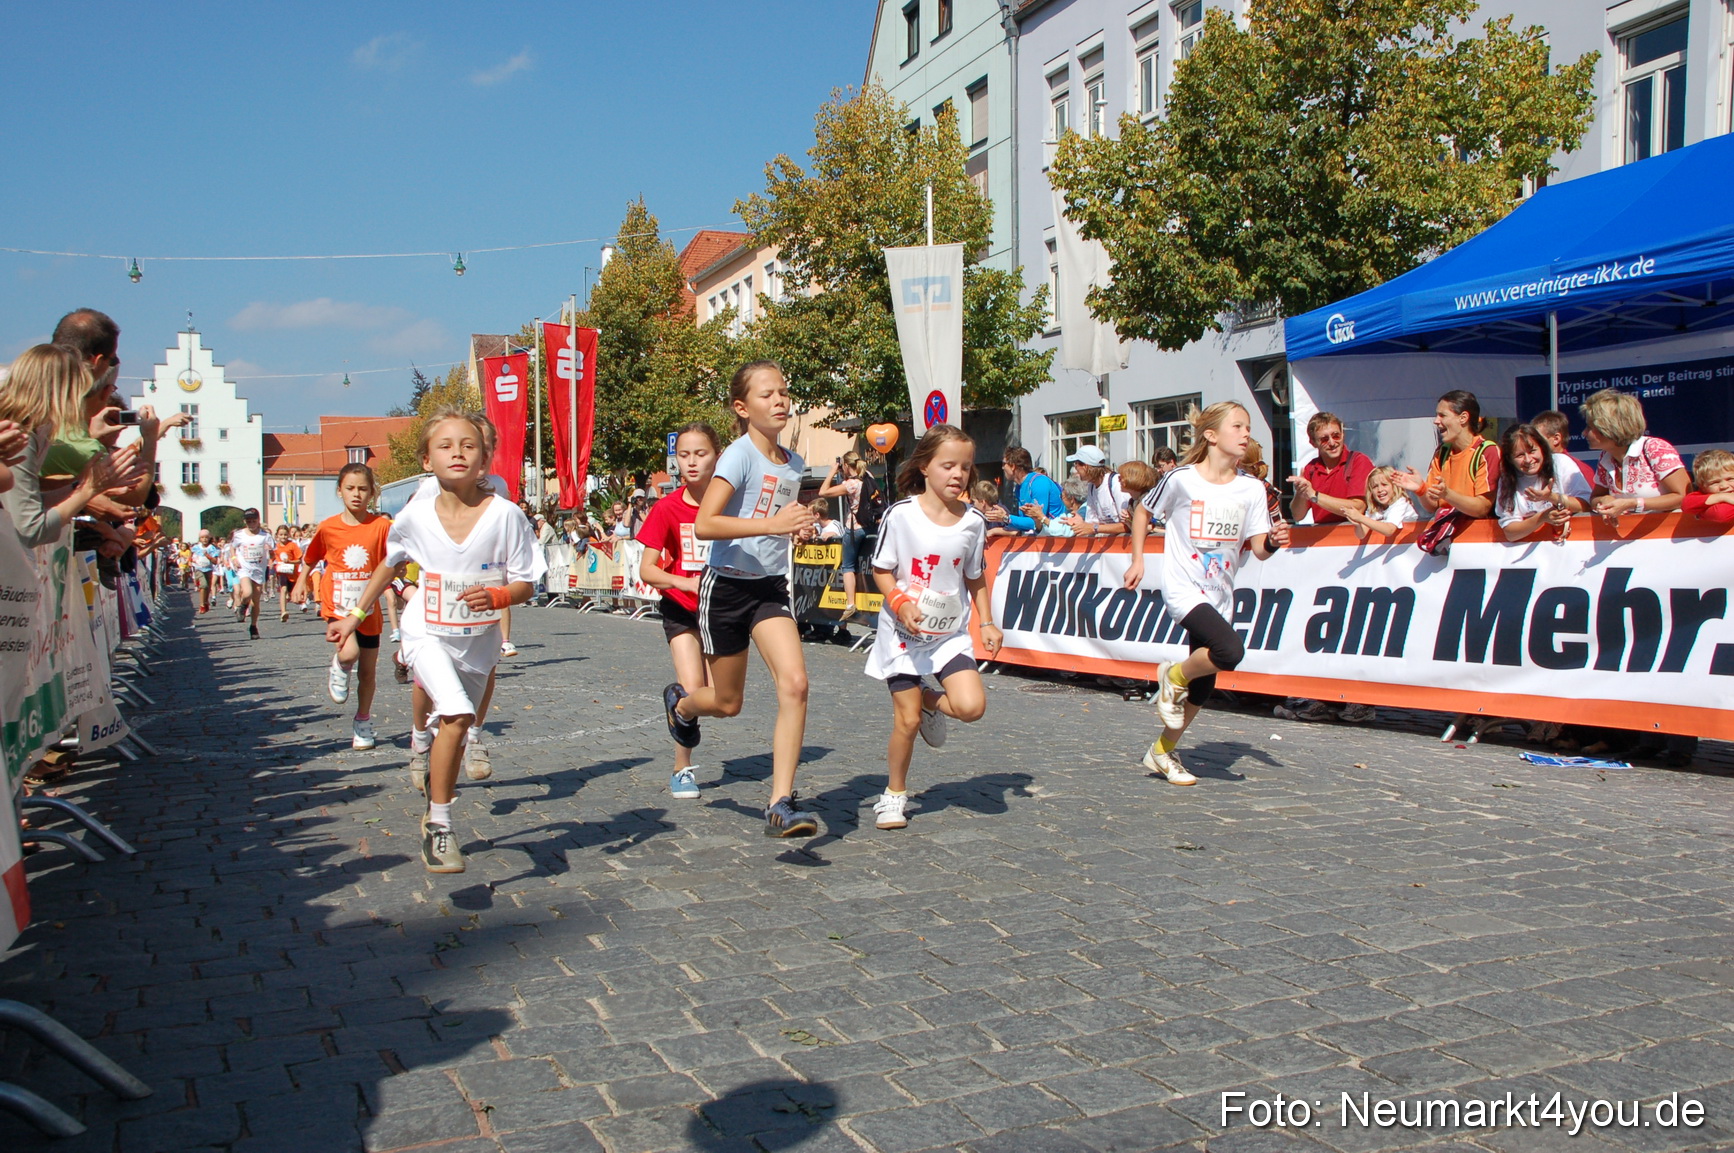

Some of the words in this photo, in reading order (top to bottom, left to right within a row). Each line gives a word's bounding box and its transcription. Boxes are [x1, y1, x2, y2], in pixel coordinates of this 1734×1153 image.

[1454, 255, 1655, 310] www.vereinigte-ikk.de
[1558, 378, 1607, 393] Typisch
[1612, 375, 1638, 388] IKK:
[1642, 373, 1664, 385] Der
[1668, 368, 1713, 383] Beitrag
[1716, 365, 1734, 377] sti
[1558, 395, 1578, 405] die
[1642, 385, 1675, 398] auch!
[777, 484, 791, 496] Anna
[1205, 506, 1240, 520] ALINA
[1207, 521, 1239, 536] 7285
[427, 595, 437, 605] K3
[828, 594, 847, 605] Neumar
[921, 594, 946, 610] Helen
[0, 613, 29, 628] ervice
[918, 612, 957, 630] 7067
[1304, 586, 1416, 658] am
[1433, 567, 1734, 676] Mehr.
